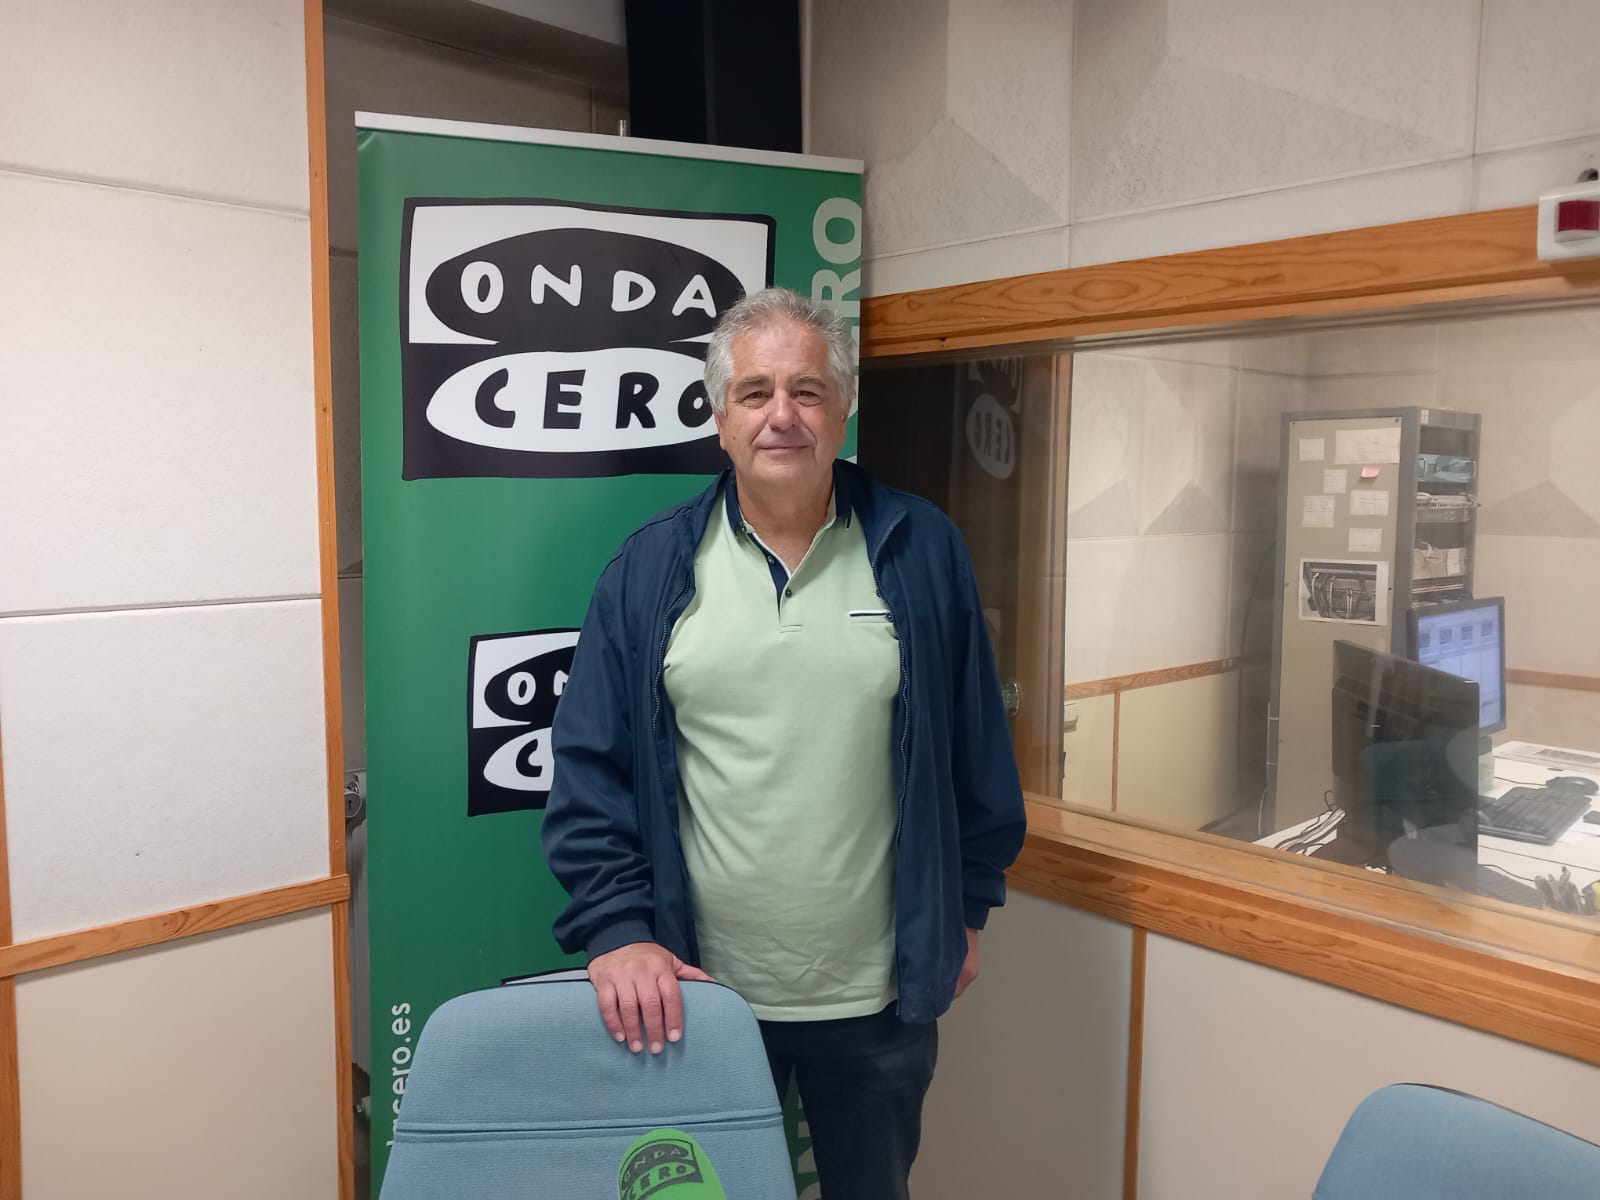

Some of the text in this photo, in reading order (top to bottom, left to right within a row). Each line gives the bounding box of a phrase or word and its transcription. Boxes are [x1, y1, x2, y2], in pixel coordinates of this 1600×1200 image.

[459, 260, 718, 319] ONDA
[474, 367, 714, 430] CERO
[623, 1148, 682, 1184] ONDA
